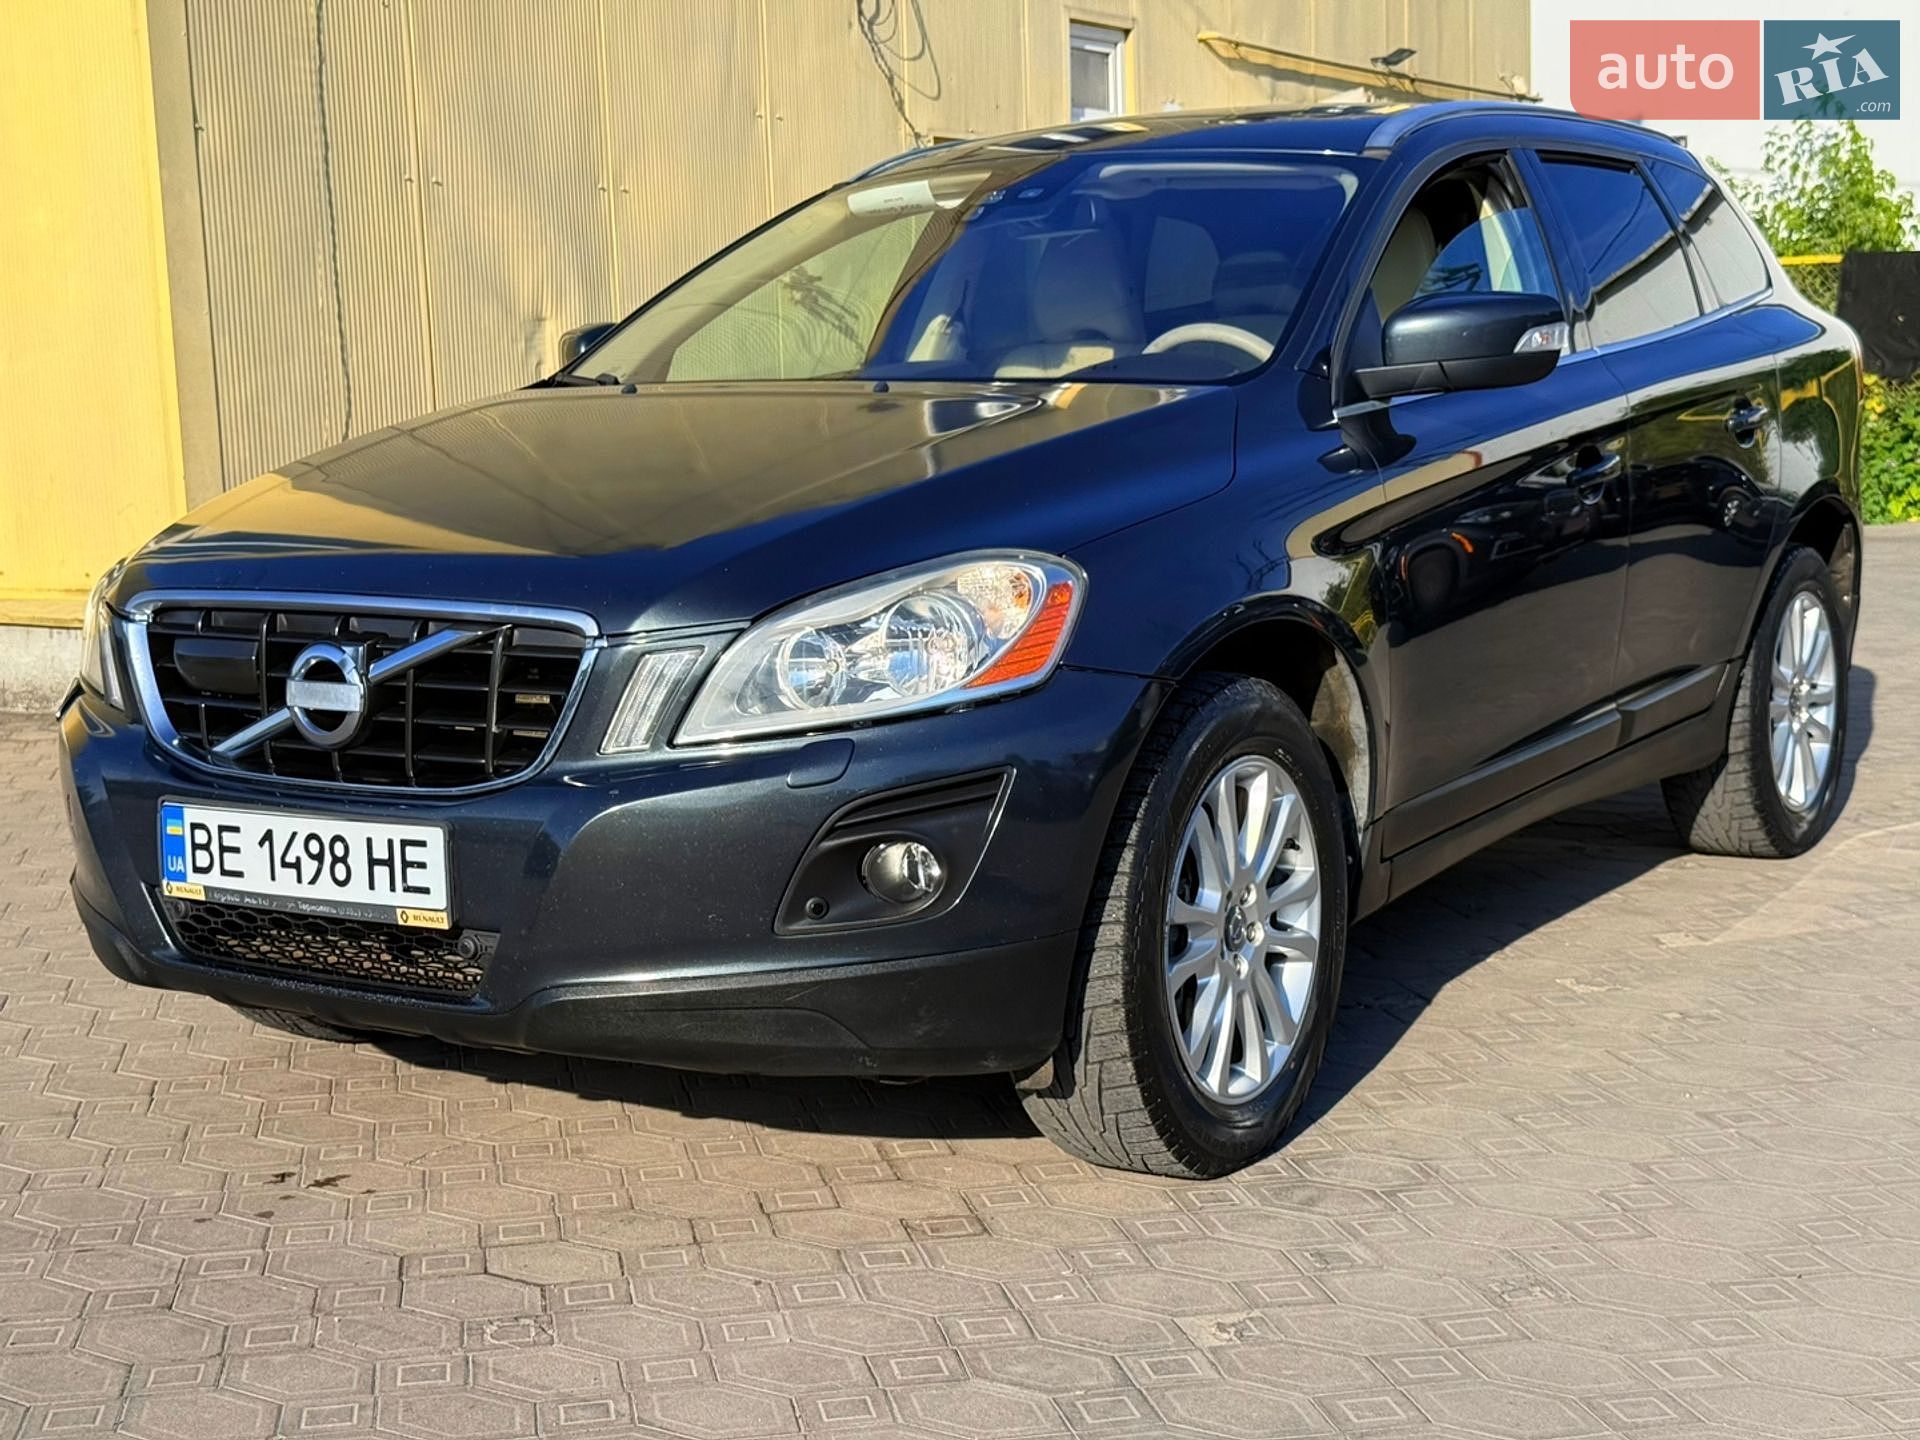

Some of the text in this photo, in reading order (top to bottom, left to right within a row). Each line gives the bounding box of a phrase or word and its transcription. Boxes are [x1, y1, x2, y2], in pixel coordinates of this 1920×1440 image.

[168, 855, 185, 873] UA
[190, 822, 430, 895] BE 1498 HE
[413, 914, 445, 924] RENAULT
